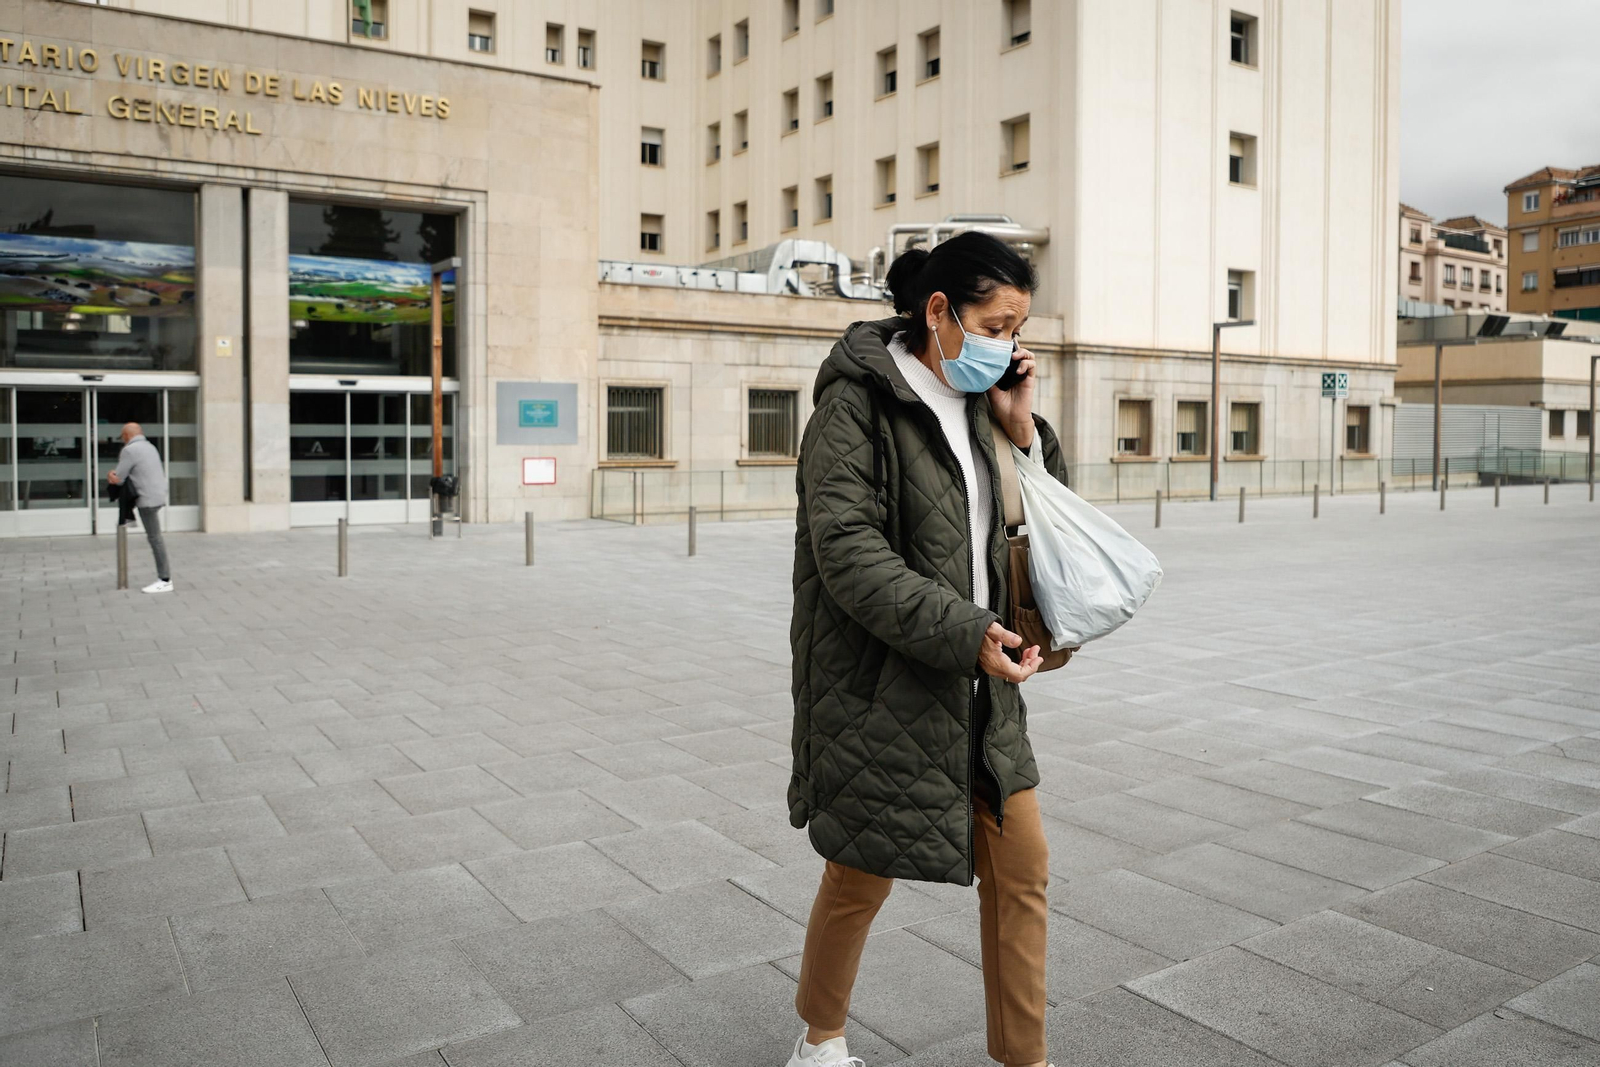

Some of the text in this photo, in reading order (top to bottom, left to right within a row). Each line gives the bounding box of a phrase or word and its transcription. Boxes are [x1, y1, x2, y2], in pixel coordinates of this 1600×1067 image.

[0, 83, 262, 136] ITAL GENERAL
[114, 53, 230, 91] VIRGEN
[245, 71, 280, 97] DE
[293, 78, 344, 105] LAS
[357, 87, 450, 119] NIEVES
